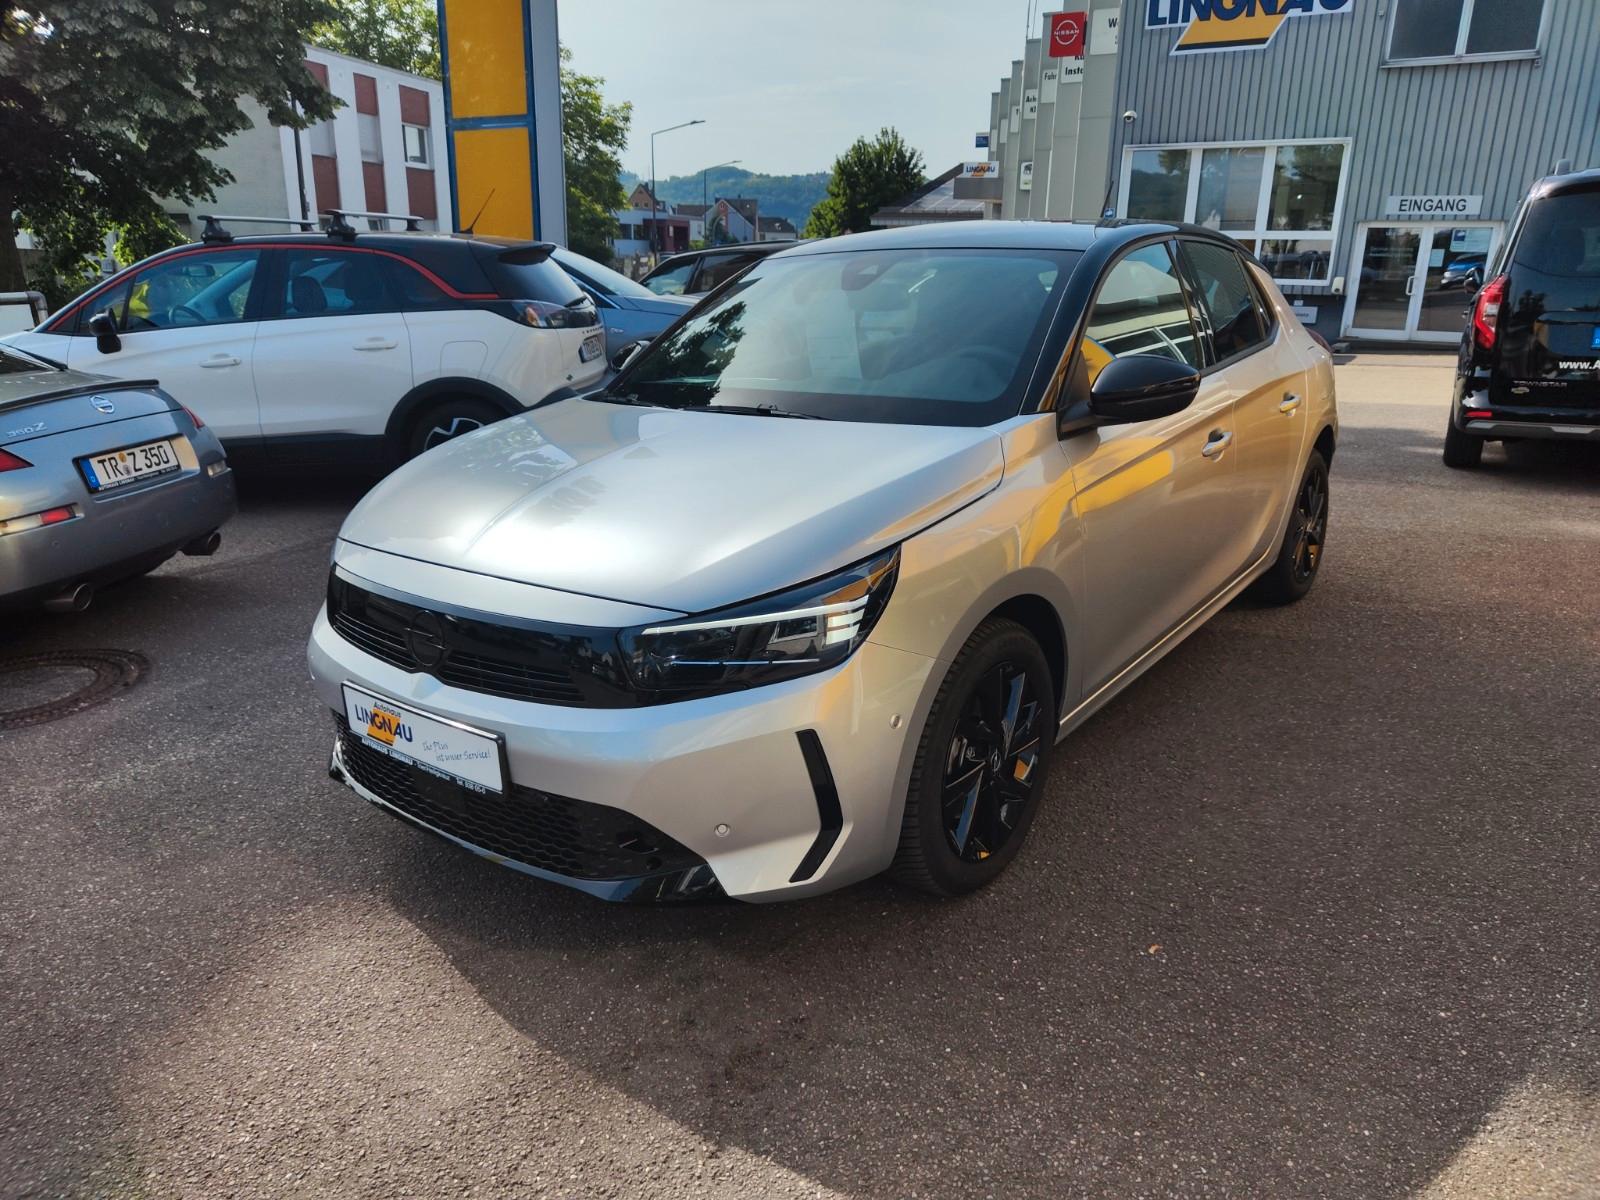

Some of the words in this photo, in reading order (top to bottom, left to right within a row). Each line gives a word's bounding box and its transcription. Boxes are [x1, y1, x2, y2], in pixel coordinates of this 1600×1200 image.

[1054, 29, 1080, 37] NISSAN
[966, 165, 995, 173] LINGNAU
[1399, 199, 1467, 212] EINGANG
[97, 457, 124, 479] TR
[127, 451, 142, 473] Z
[140, 445, 170, 469] 350
[374, 702, 402, 718] Autohaus
[354, 704, 413, 742] LINGNAU
